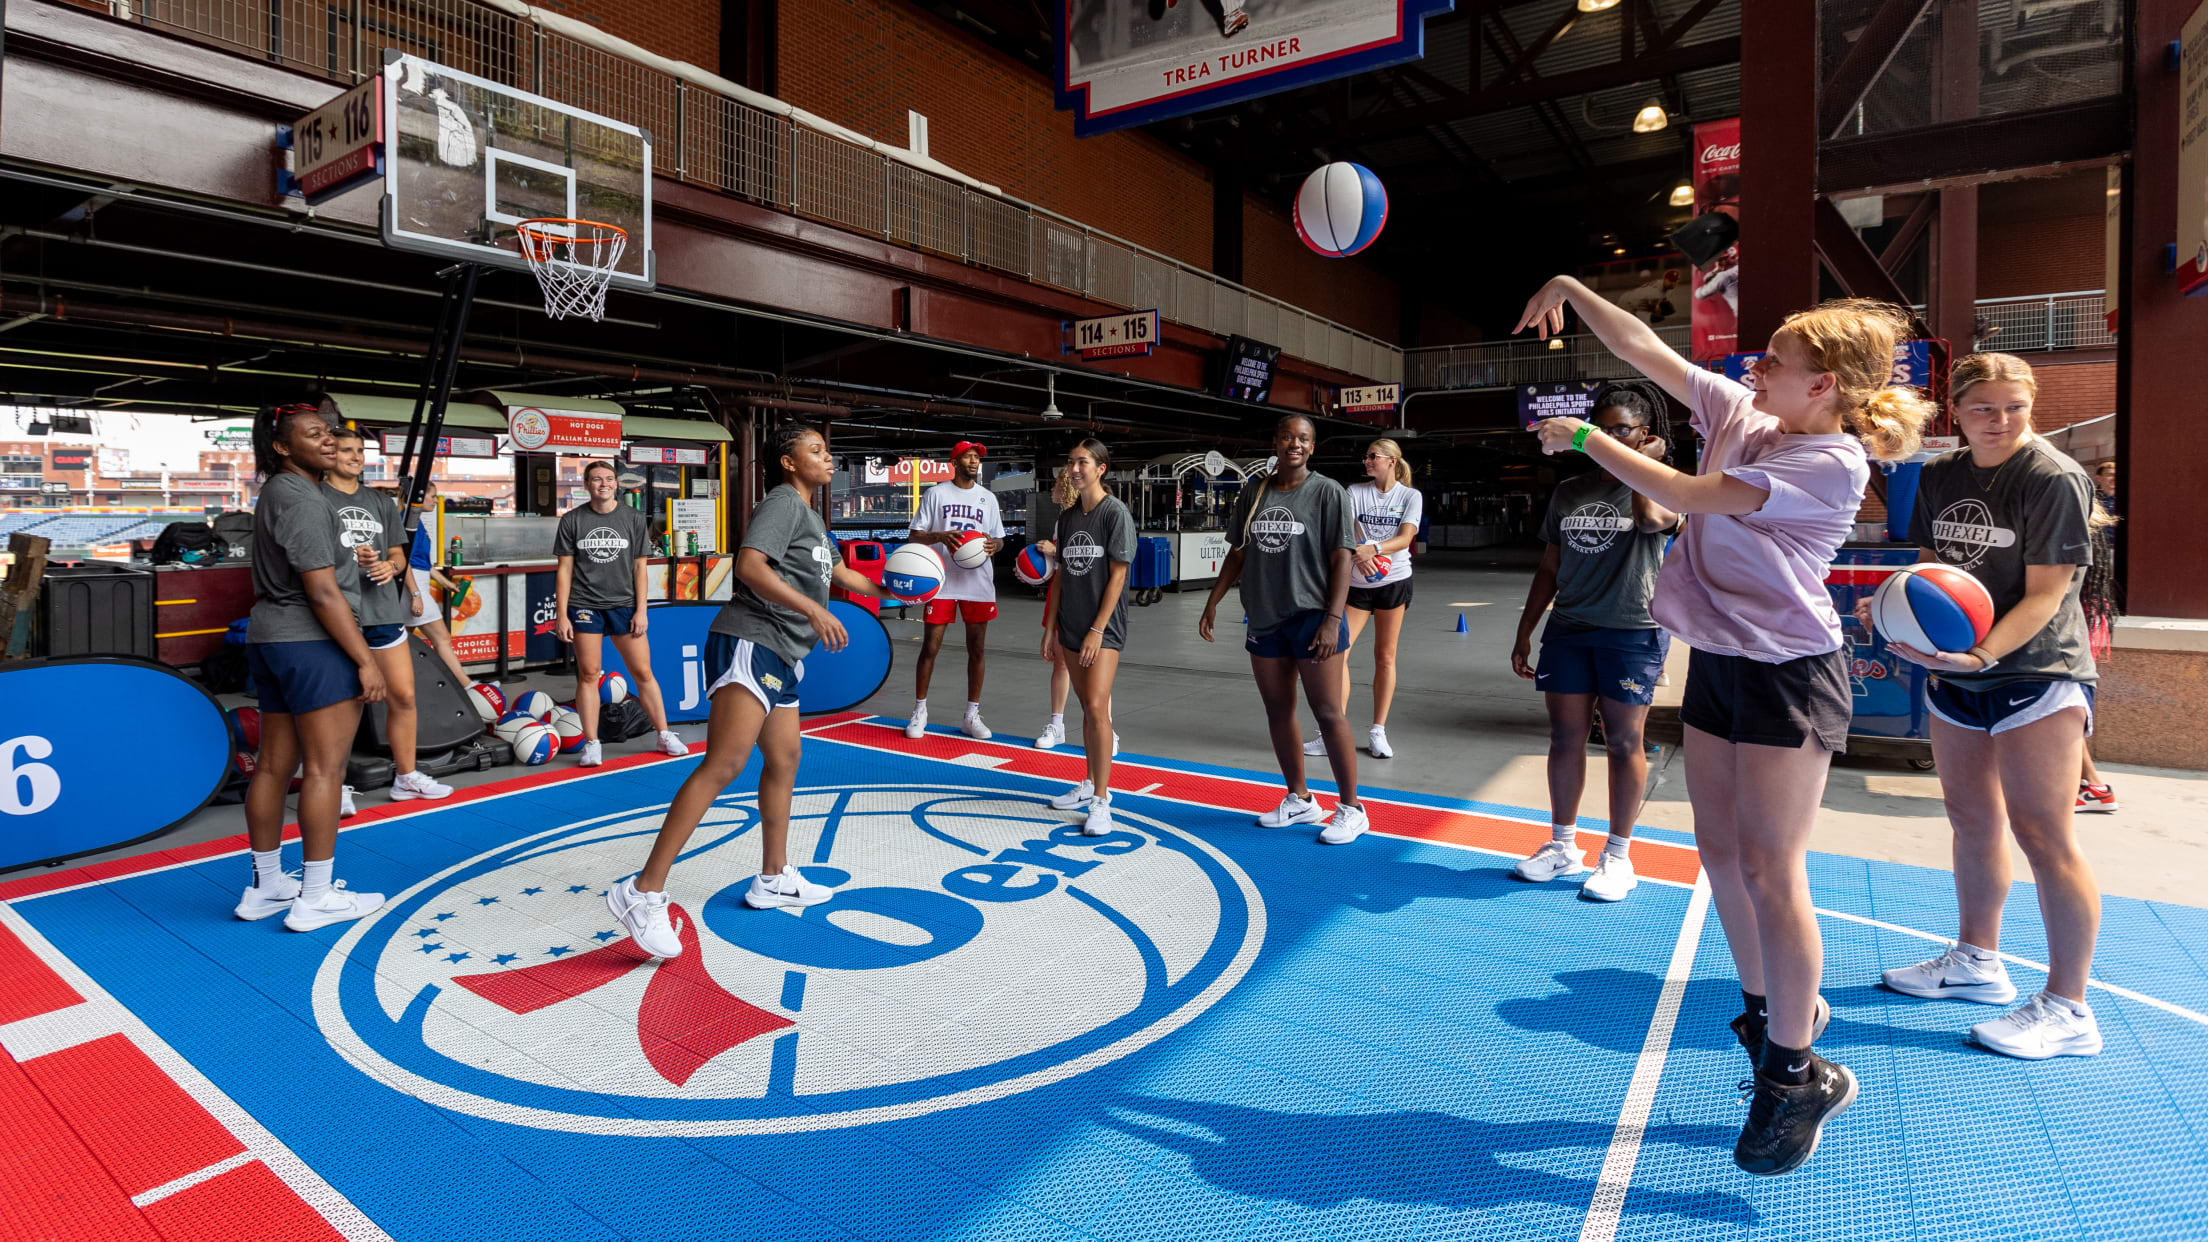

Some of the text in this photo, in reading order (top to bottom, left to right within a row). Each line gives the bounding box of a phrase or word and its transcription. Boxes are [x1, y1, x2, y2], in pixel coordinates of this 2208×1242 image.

[1163, 37, 1301, 87] TREA TURNER
[299, 90, 370, 168] 115 116
[311, 154, 359, 188] SECTIONS
[1080, 316, 1148, 345] 114 115
[1092, 344, 1136, 356] SECTIONS
[1344, 387, 1394, 404] 113 114
[1575, 393, 1587, 401] THE
[1353, 404, 1386, 412] SECTIONS
[1528, 399, 1595, 410] PHILADELPHIA SPORTS
[1555, 407, 1586, 415] INITIATIVE
[515, 422, 546, 436] Phillies
[569, 421, 585, 429] HOT
[553, 434, 619, 444] ITALIAN SAUSAGES
[894, 459, 950, 475] TOOTA
[1363, 516, 1399, 526] DREXEL
[1564, 518, 1623, 529] DREXEL
[1252, 522, 1298, 532] DREXEL
[1200, 547, 1227, 560] ULTRA
[457, 639, 491, 649] CHOICE
